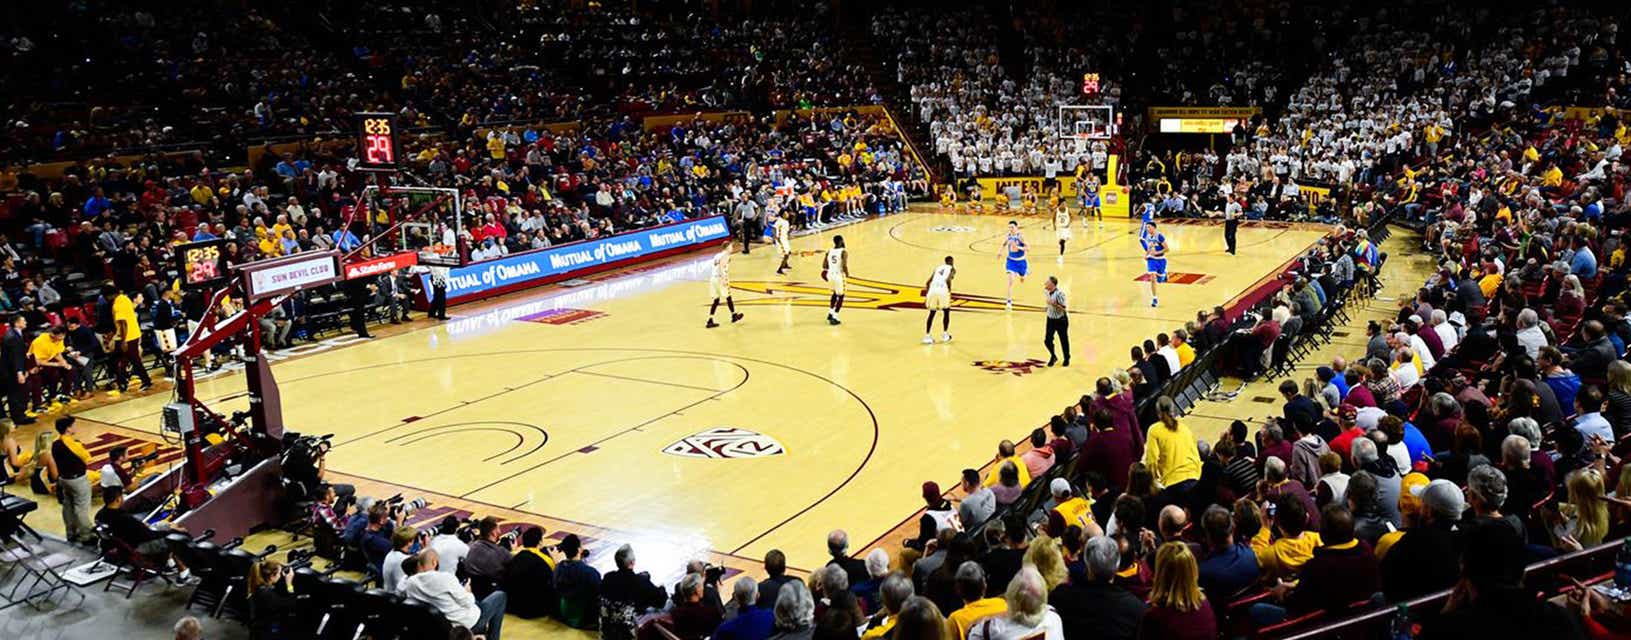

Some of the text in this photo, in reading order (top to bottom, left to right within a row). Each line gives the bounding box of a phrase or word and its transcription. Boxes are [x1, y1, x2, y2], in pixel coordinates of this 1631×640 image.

[1083, 80, 1098, 94] 29
[364, 119, 391, 134] 12:35
[367, 135, 391, 163] 29
[686, 226, 696, 243] of
[187, 245, 220, 262] 12:35
[550, 240, 642, 269] MUTUAL of OMAHA
[831, 255, 838, 264] 5
[192, 260, 215, 281] 29
[271, 264, 329, 284] SUN DEVIL CLUB
[482, 266, 496, 285] of
[496, 261, 541, 280] OMAHA
[939, 268, 945, 276] 4
